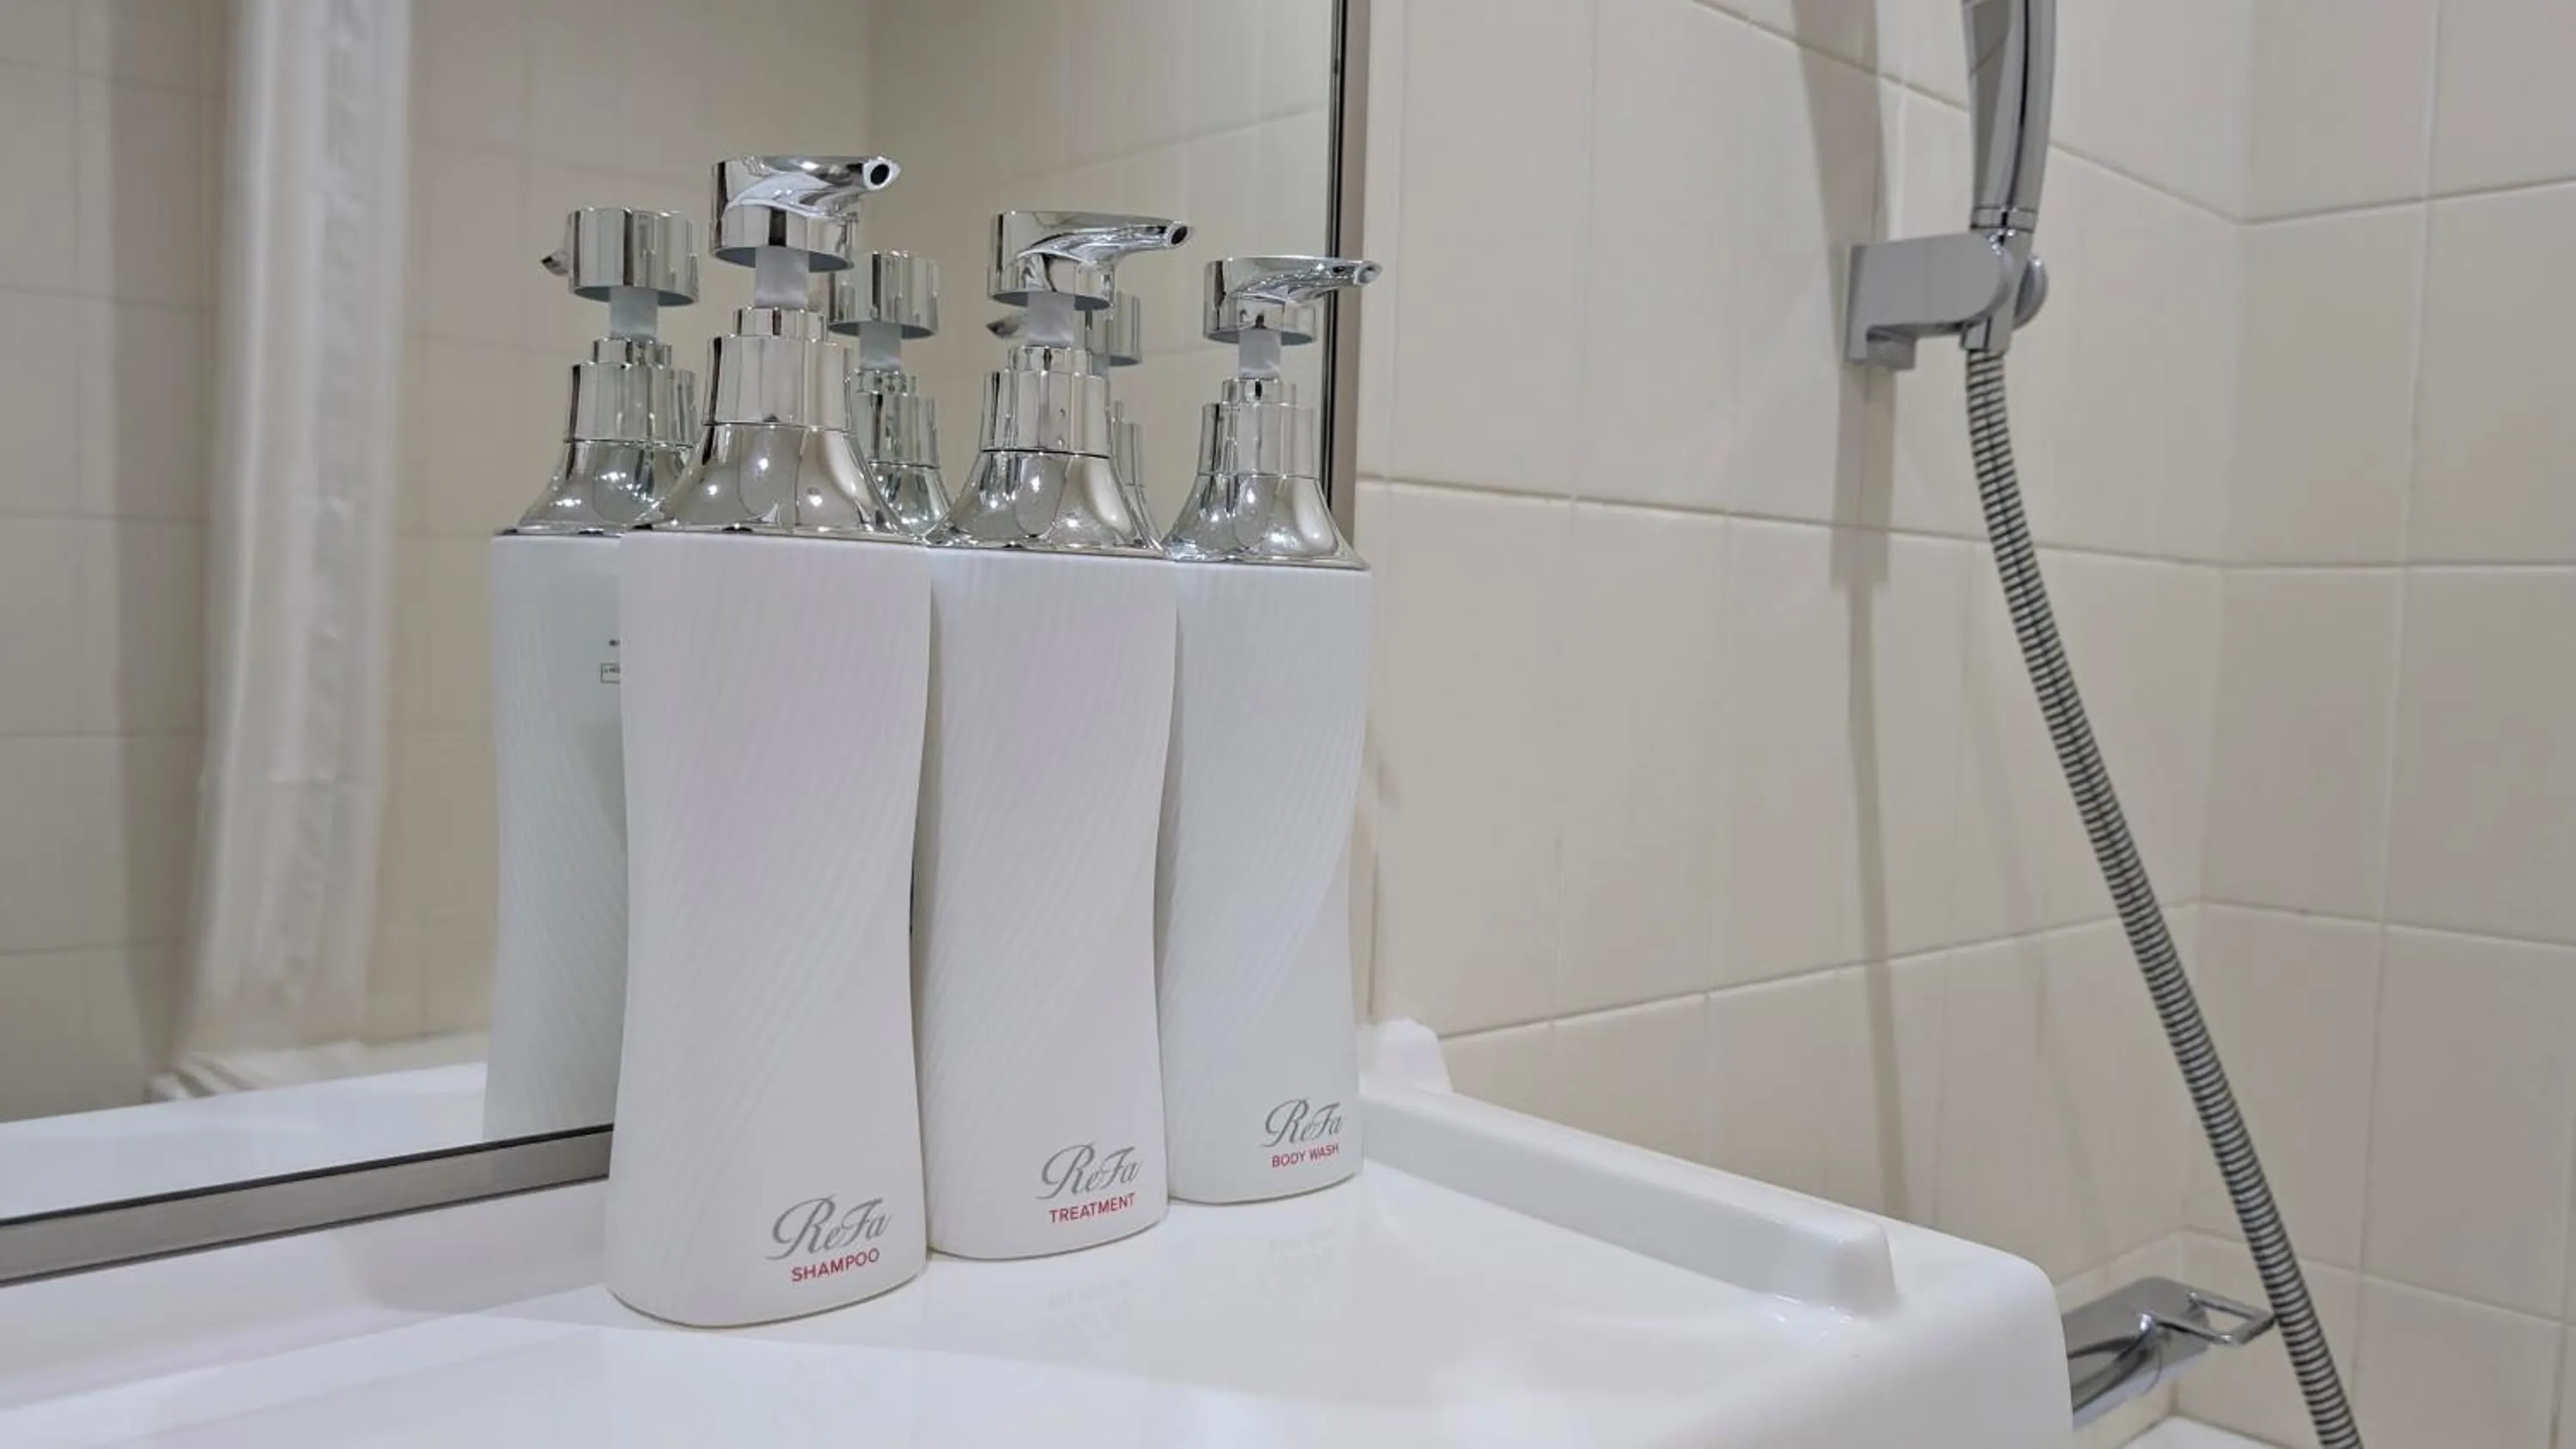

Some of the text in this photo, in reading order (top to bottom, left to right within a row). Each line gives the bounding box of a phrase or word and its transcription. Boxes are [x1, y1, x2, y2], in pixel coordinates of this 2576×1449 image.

[1261, 1098, 1343, 1148] ReFa
[1035, 1142, 1140, 1200] ReFa
[1272, 1143, 1339, 1168] BODY WASH
[765, 1193, 892, 1260] ReFa
[1048, 1192, 1135, 1223] TREATMENT
[791, 1247, 880, 1282] SHAMPOO
